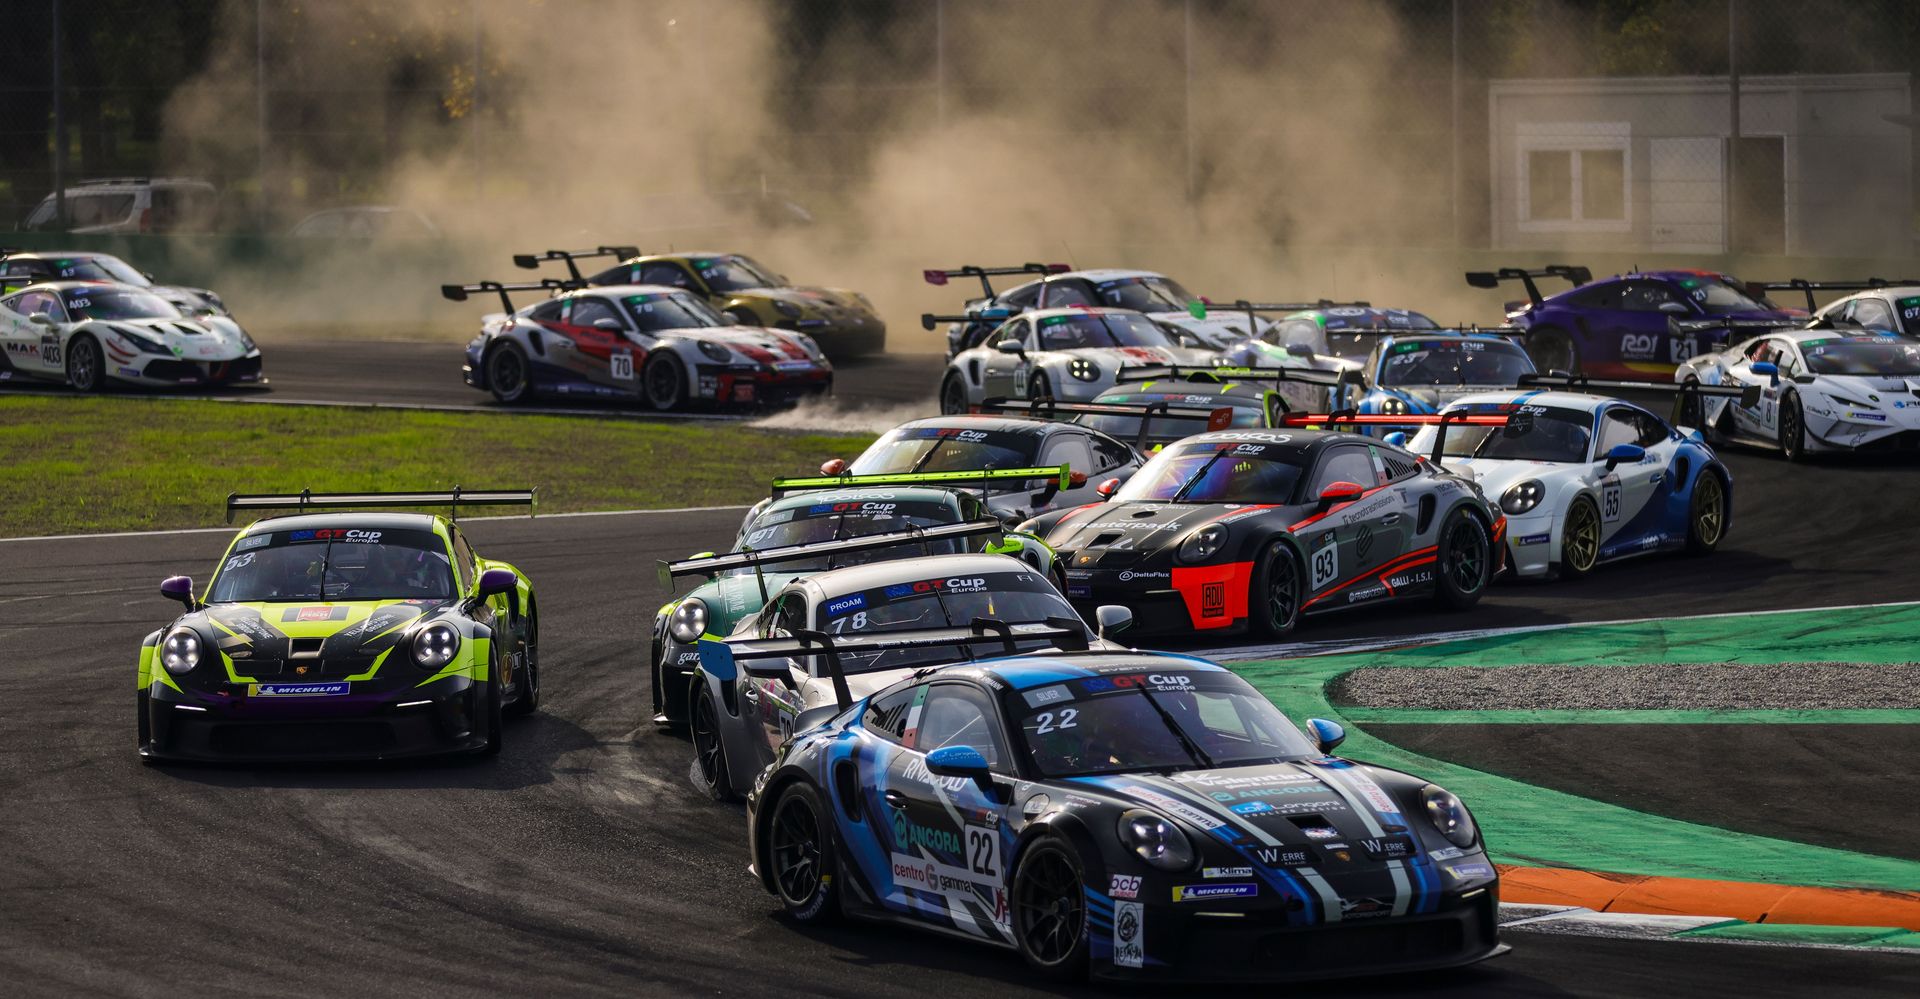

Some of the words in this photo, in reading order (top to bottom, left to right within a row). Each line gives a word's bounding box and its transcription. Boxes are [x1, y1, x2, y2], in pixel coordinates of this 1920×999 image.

[69, 299, 92, 310] 403
[1904, 306, 1920, 319] 67
[7, 342, 38, 354] MAK
[1676, 339, 1694, 358] 21
[42, 345, 62, 365] 403
[615, 356, 631, 377] 70
[1765, 401, 1772, 422] 8
[959, 429, 989, 439] Cup
[1236, 443, 1266, 453] Cup
[832, 502, 863, 513] GT
[861, 502, 897, 513] Cup
[1604, 486, 1620, 518] 55
[315, 528, 347, 539] GT
[345, 529, 382, 541] Cup
[224, 552, 256, 571] 53
[1315, 549, 1334, 584] 93
[1133, 570, 1170, 579] DeltaFlux
[912, 579, 945, 592] GT
[946, 578, 986, 590] Cup
[1391, 575, 1411, 588] GALLI
[951, 585, 988, 594] Europe
[829, 597, 863, 612] PROAM
[831, 611, 868, 634] 78
[1113, 674, 1148, 688] GT
[1148, 673, 1191, 688] Cup
[277, 685, 342, 694] MICHELIN
[1036, 689, 1060, 701] SILVER
[1157, 684, 1197, 693] Europe
[1037, 708, 1078, 735] 22
[1238, 785, 1335, 798] ANCORA
[985, 810, 999, 824] Cup
[909, 823, 961, 854] ANCORA
[970, 830, 997, 877] 22
[894, 862, 925, 882] centro
[939, 873, 972, 894] gamma
[1219, 867, 1252, 876] Klima
[1196, 887, 1248, 897] MICHELIN
